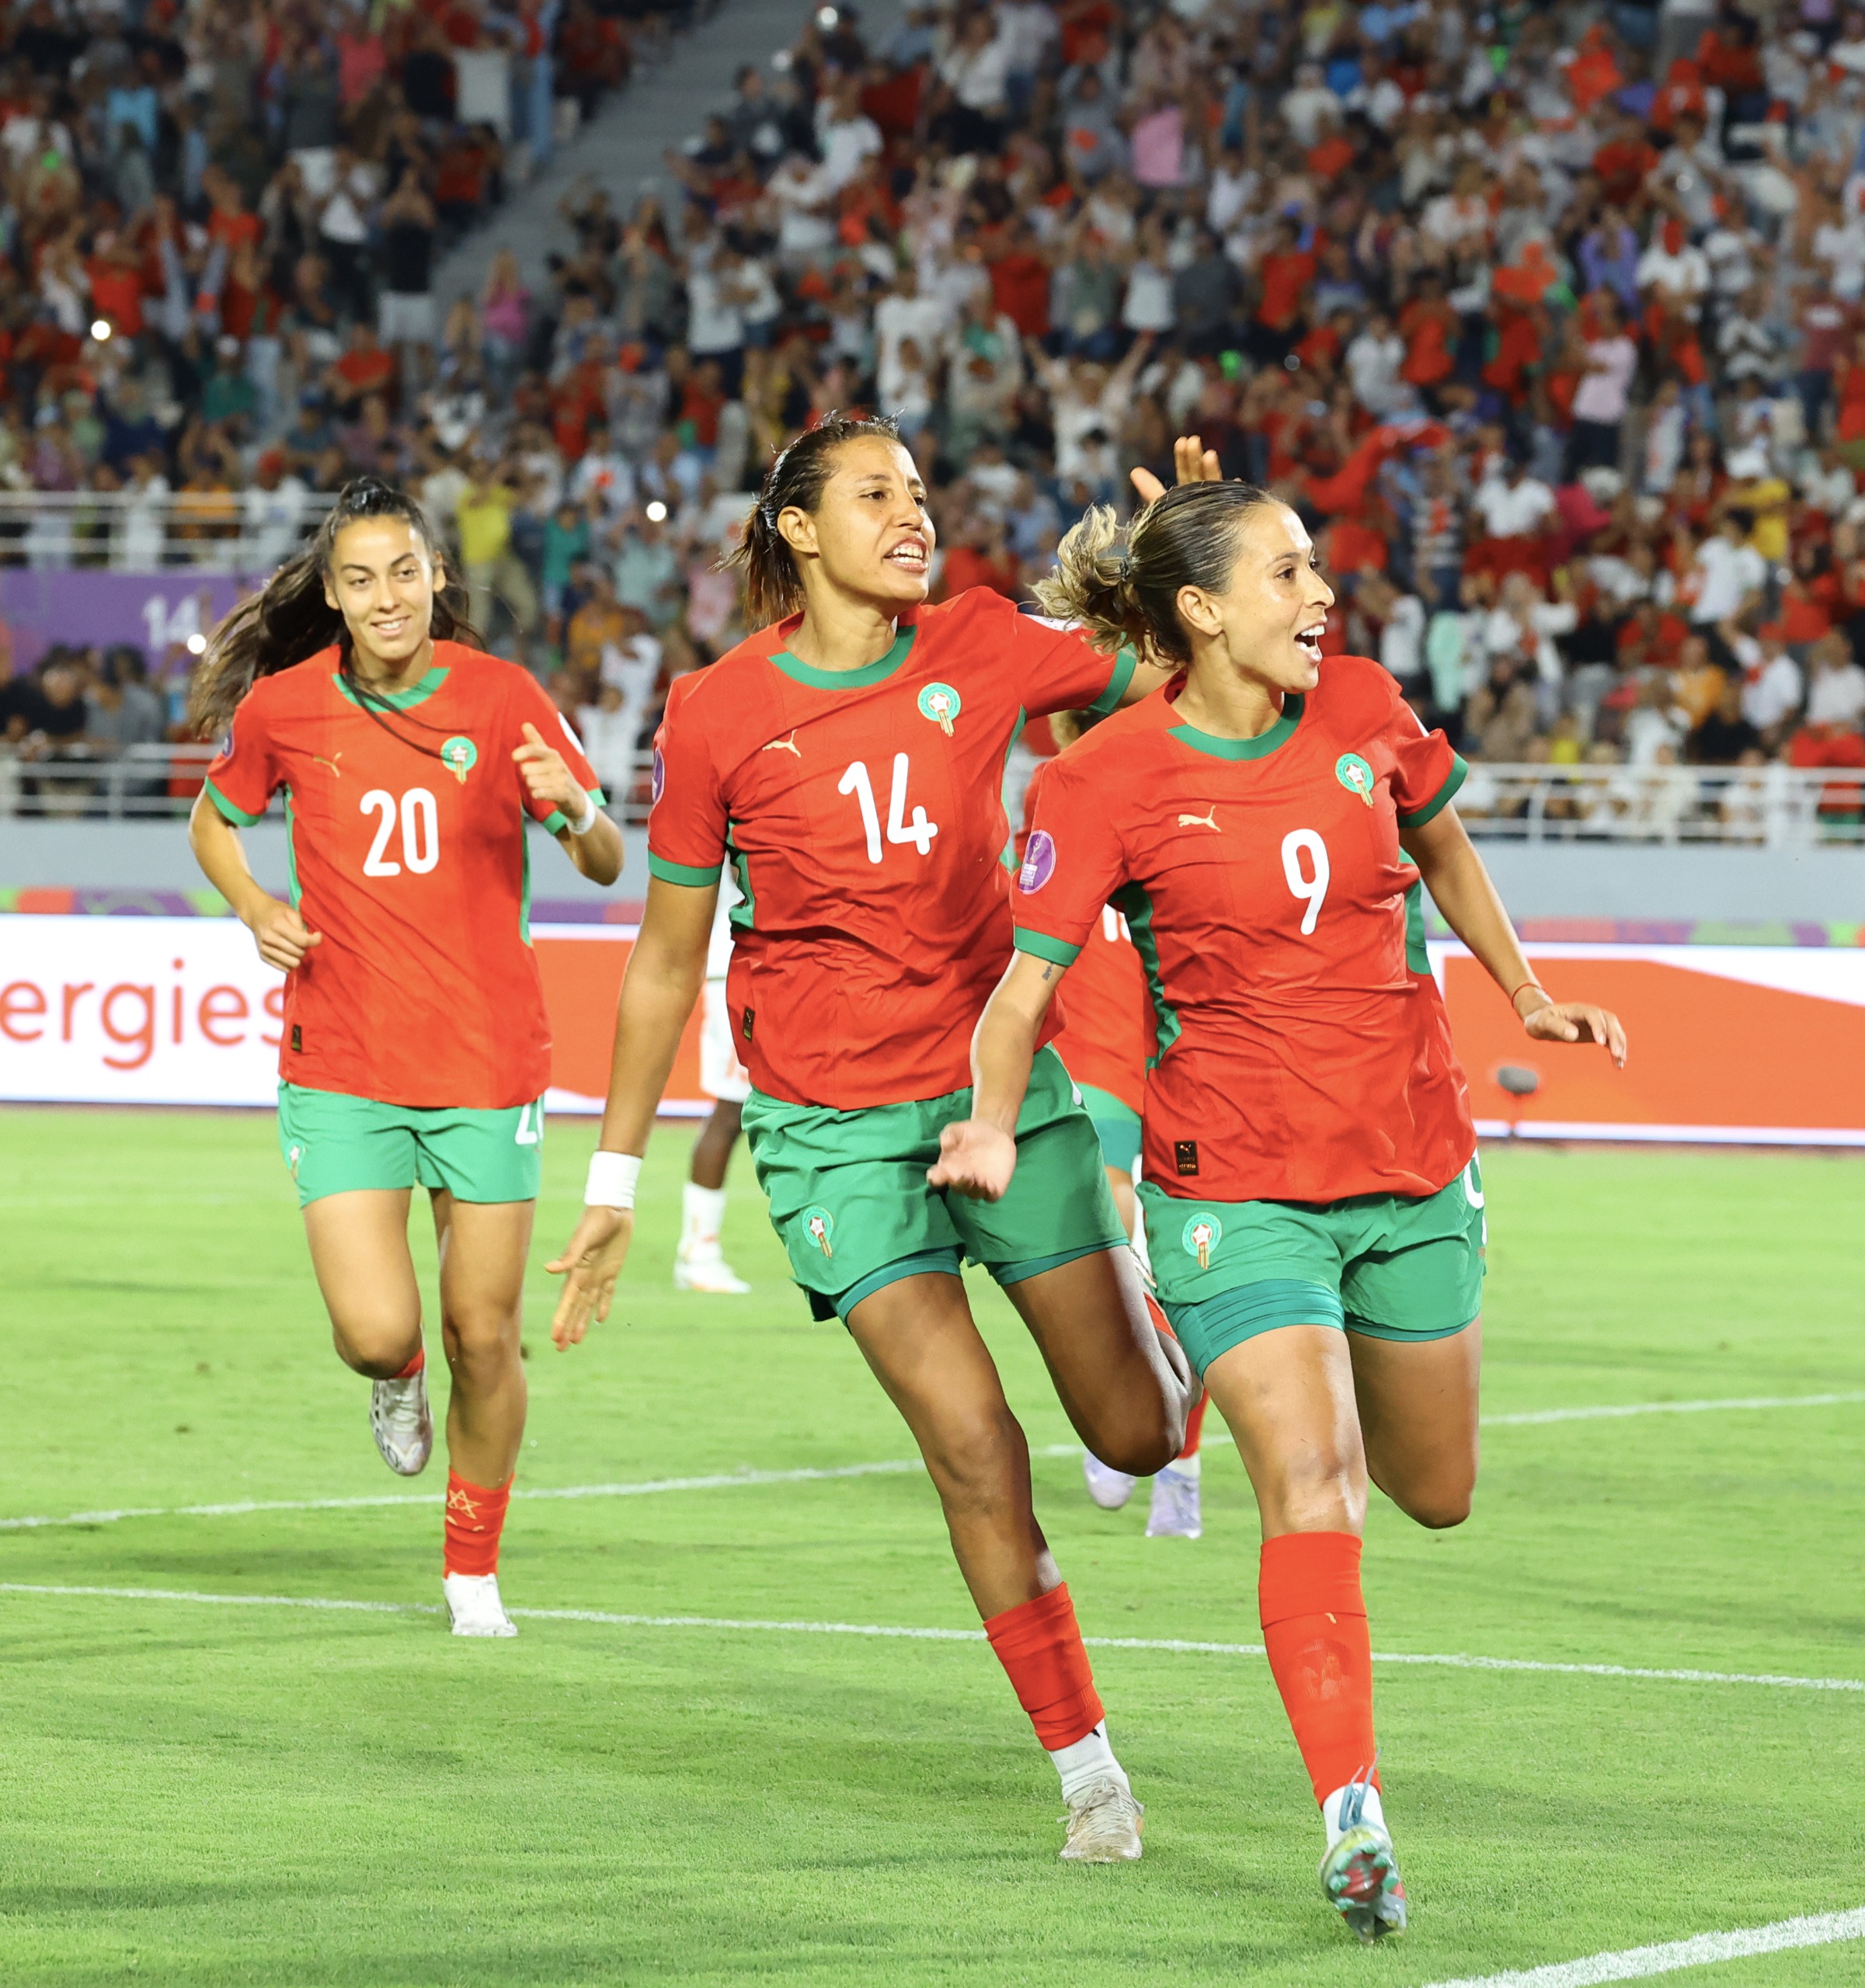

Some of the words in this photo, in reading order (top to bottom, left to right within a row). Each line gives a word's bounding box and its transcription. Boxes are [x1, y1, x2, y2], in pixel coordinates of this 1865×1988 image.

[360, 787, 440, 877] 20
[838, 752, 938, 864] 14
[1281, 829, 1330, 936] 9
